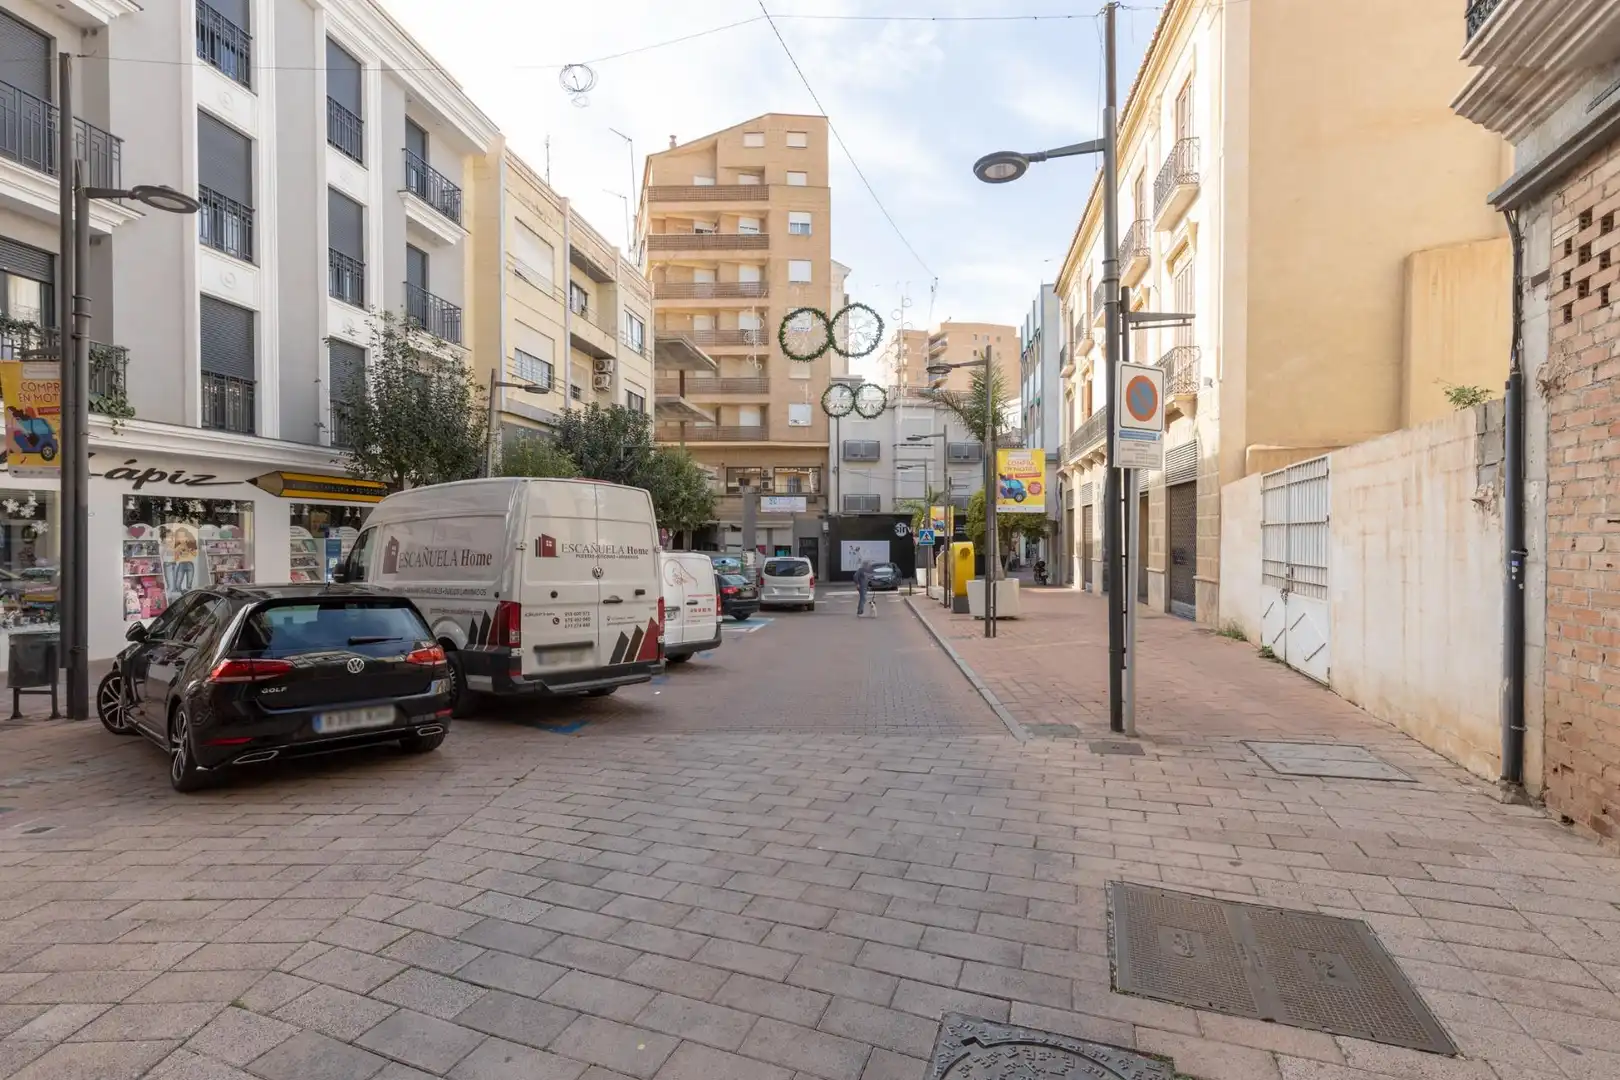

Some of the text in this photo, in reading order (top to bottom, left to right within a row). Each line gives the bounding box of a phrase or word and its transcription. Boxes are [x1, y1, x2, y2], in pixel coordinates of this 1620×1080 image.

[21, 381, 60, 393] COMPR
[33, 393, 59, 403] MOT
[88, 452, 244, 490] ápiz
[561, 542, 649, 555] ESCAÑUELA Home
[399, 546, 493, 569] ESCAÑUELA Home
[261, 686, 288, 694] GOLF
